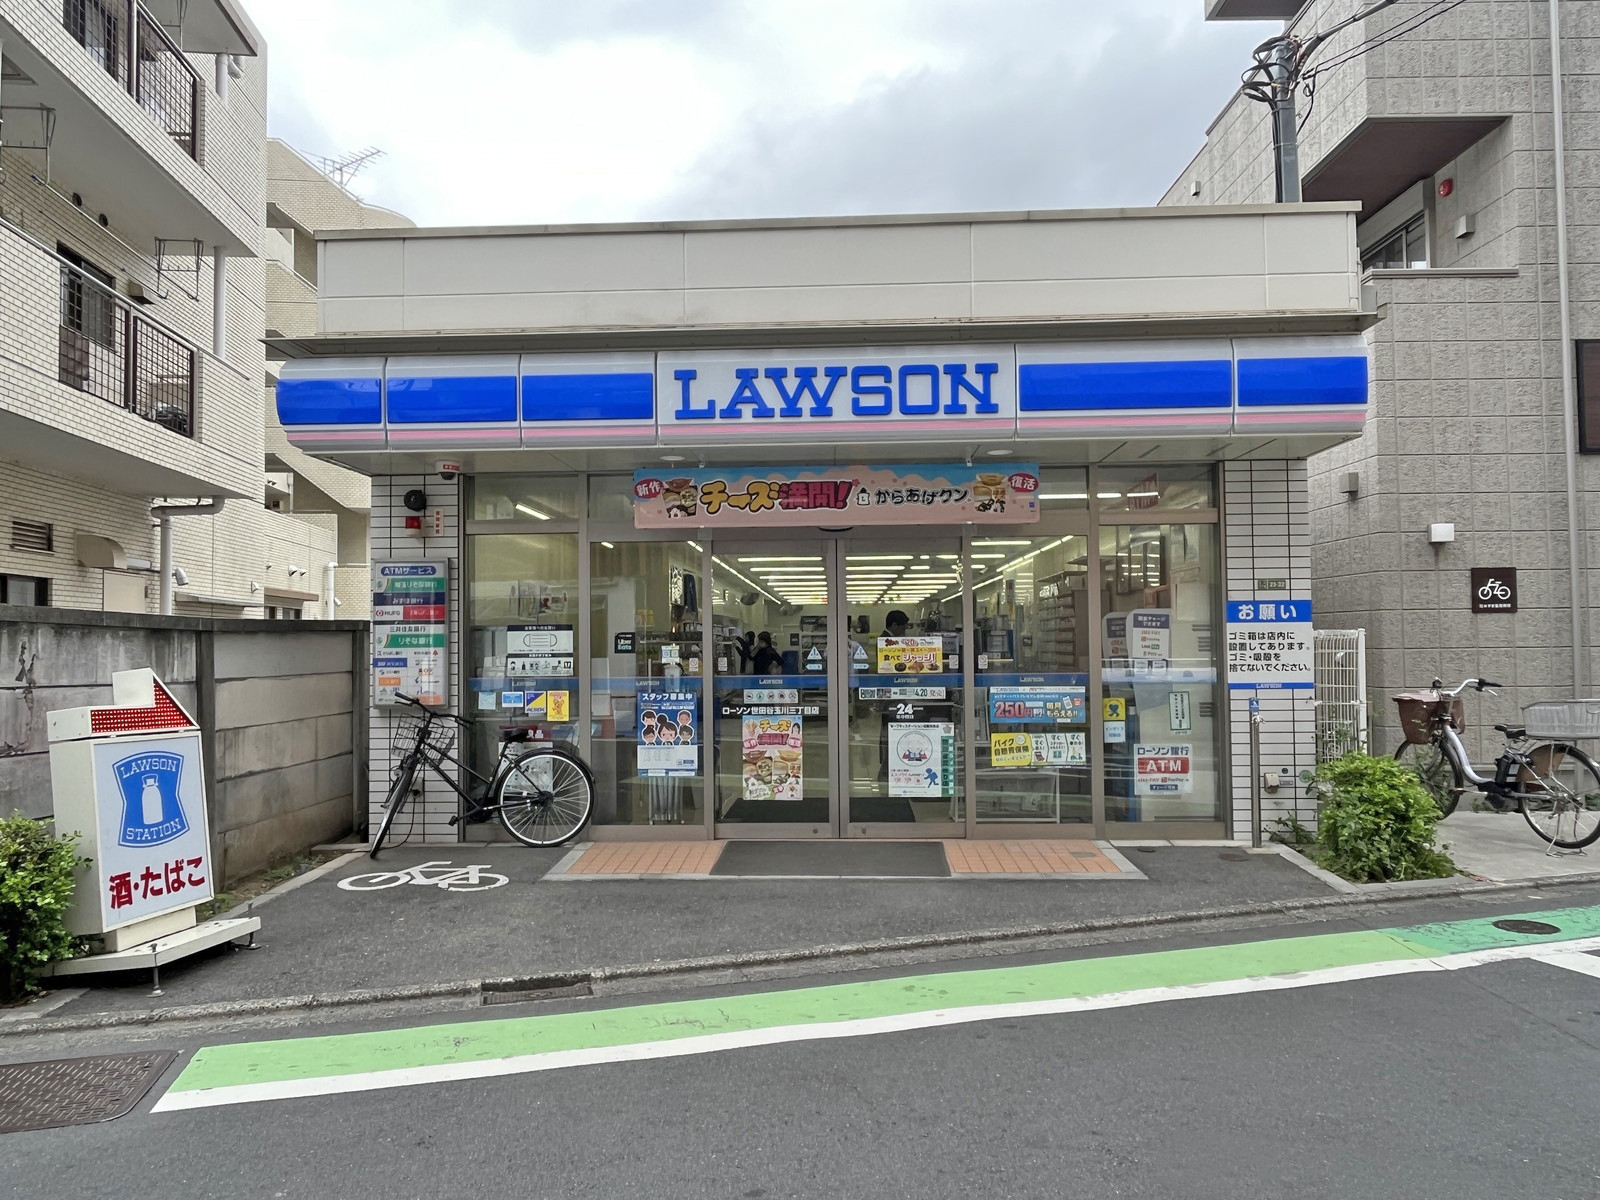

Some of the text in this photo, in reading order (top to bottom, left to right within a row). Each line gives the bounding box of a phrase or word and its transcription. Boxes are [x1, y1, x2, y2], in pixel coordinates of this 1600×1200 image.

[673, 362, 999, 420] LAWSON
[1011, 476, 1036, 490] 復活
[637, 482, 663, 498] 新作
[875, 487, 969, 505] からあげクン
[384, 567, 433, 575] ATMサービス
[1238, 603, 1297, 621] お願い
[398, 637, 433, 645] りそな銀行
[1229, 631, 1296, 641] ゴミ箱は店内に
[1229, 642, 1311, 651] 設置してあります。
[1229, 652, 1281, 661] ゴミ・吸殻を
[1229, 663, 1311, 673] 捨てないでください。
[642, 693, 693, 701] スタッフ募集中
[722, 706, 820, 715] ローソン世田谷玉川三丁目店
[896, 703, 914, 715] 24
[760, 719, 791, 732] チーズ
[994, 738, 1015, 748] バイク
[1137, 746, 1190, 756] ローソン銀行
[119, 757, 177, 779] LAWSON
[1146, 759, 1182, 772] ATM
[126, 817, 181, 841] STATION
[108, 856, 206, 910] 酒・たばこ
